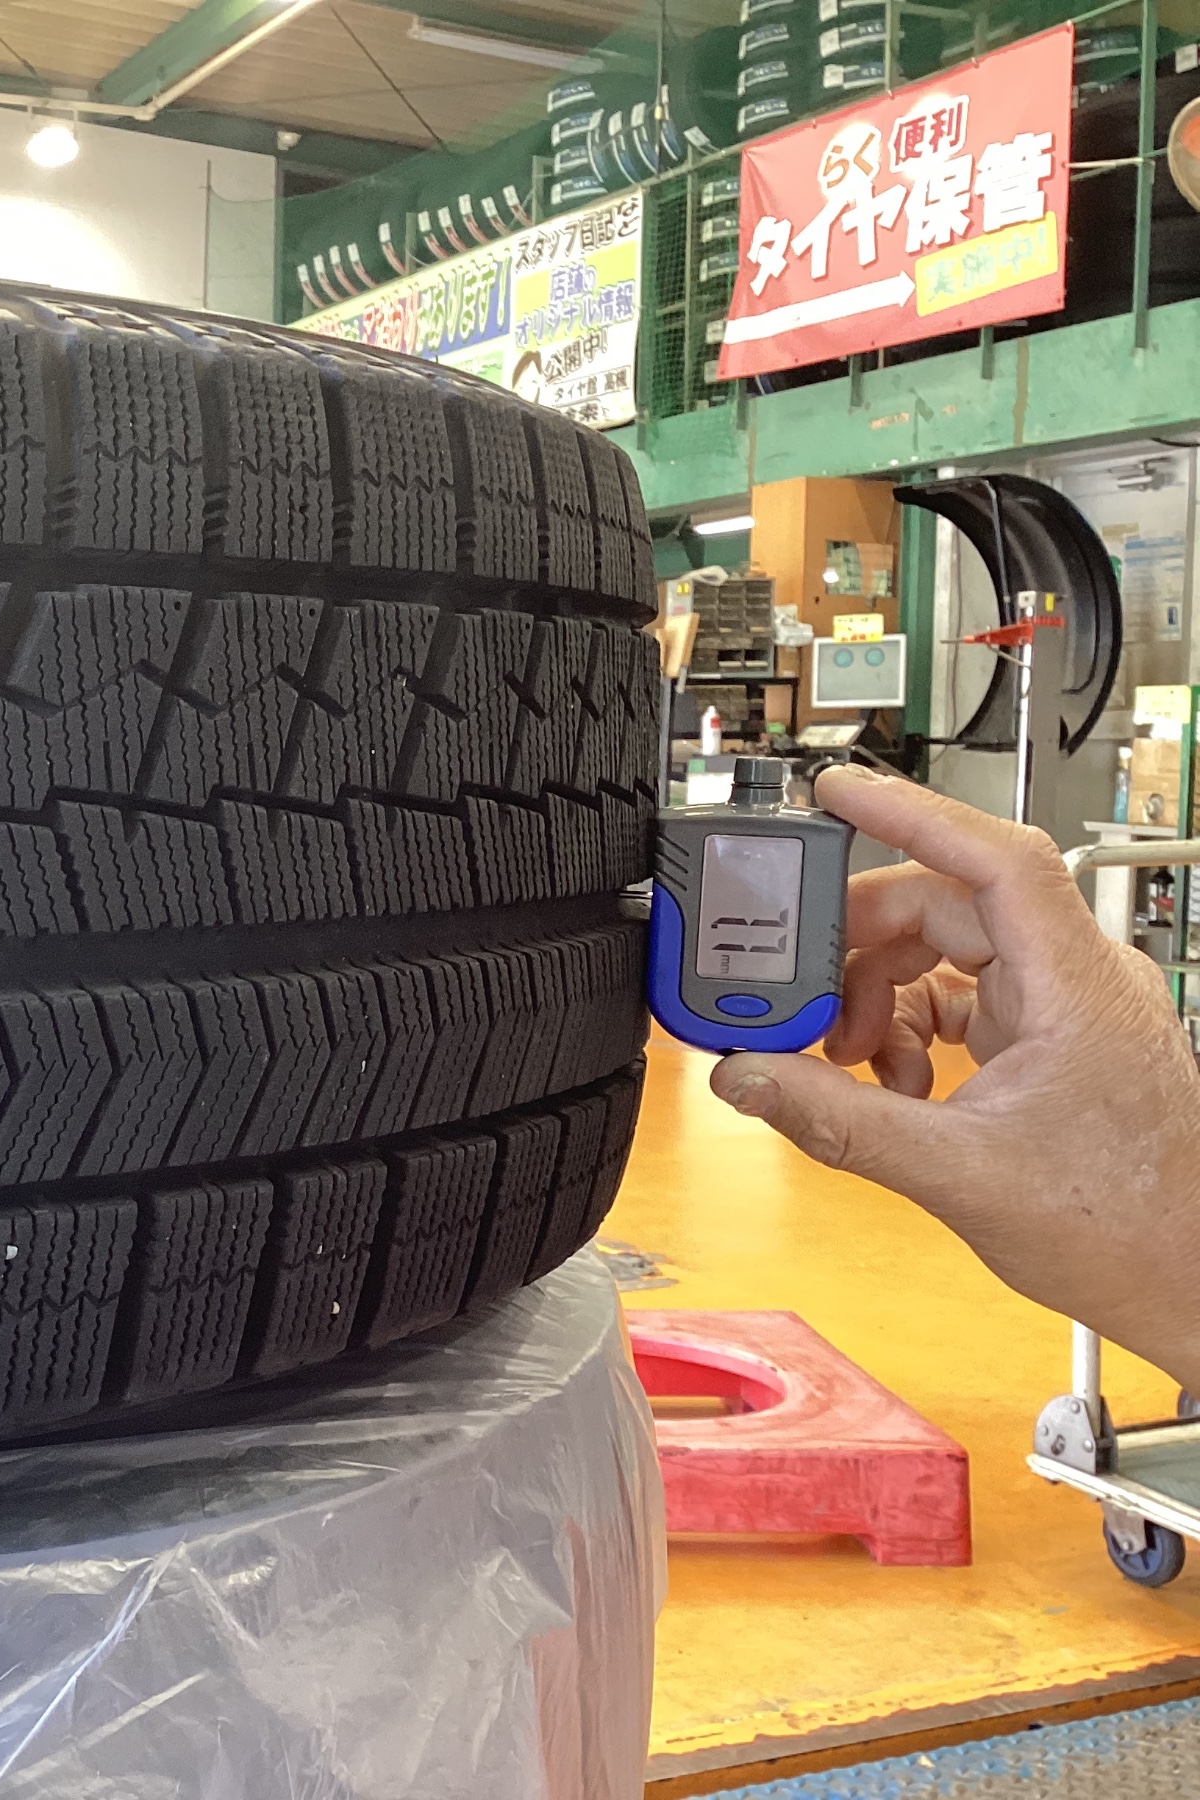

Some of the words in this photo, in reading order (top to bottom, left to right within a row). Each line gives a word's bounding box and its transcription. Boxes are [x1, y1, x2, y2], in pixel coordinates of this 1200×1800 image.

[746, 131, 1054, 298] タイヤ保管
[721, 954, 730, 975] mm
